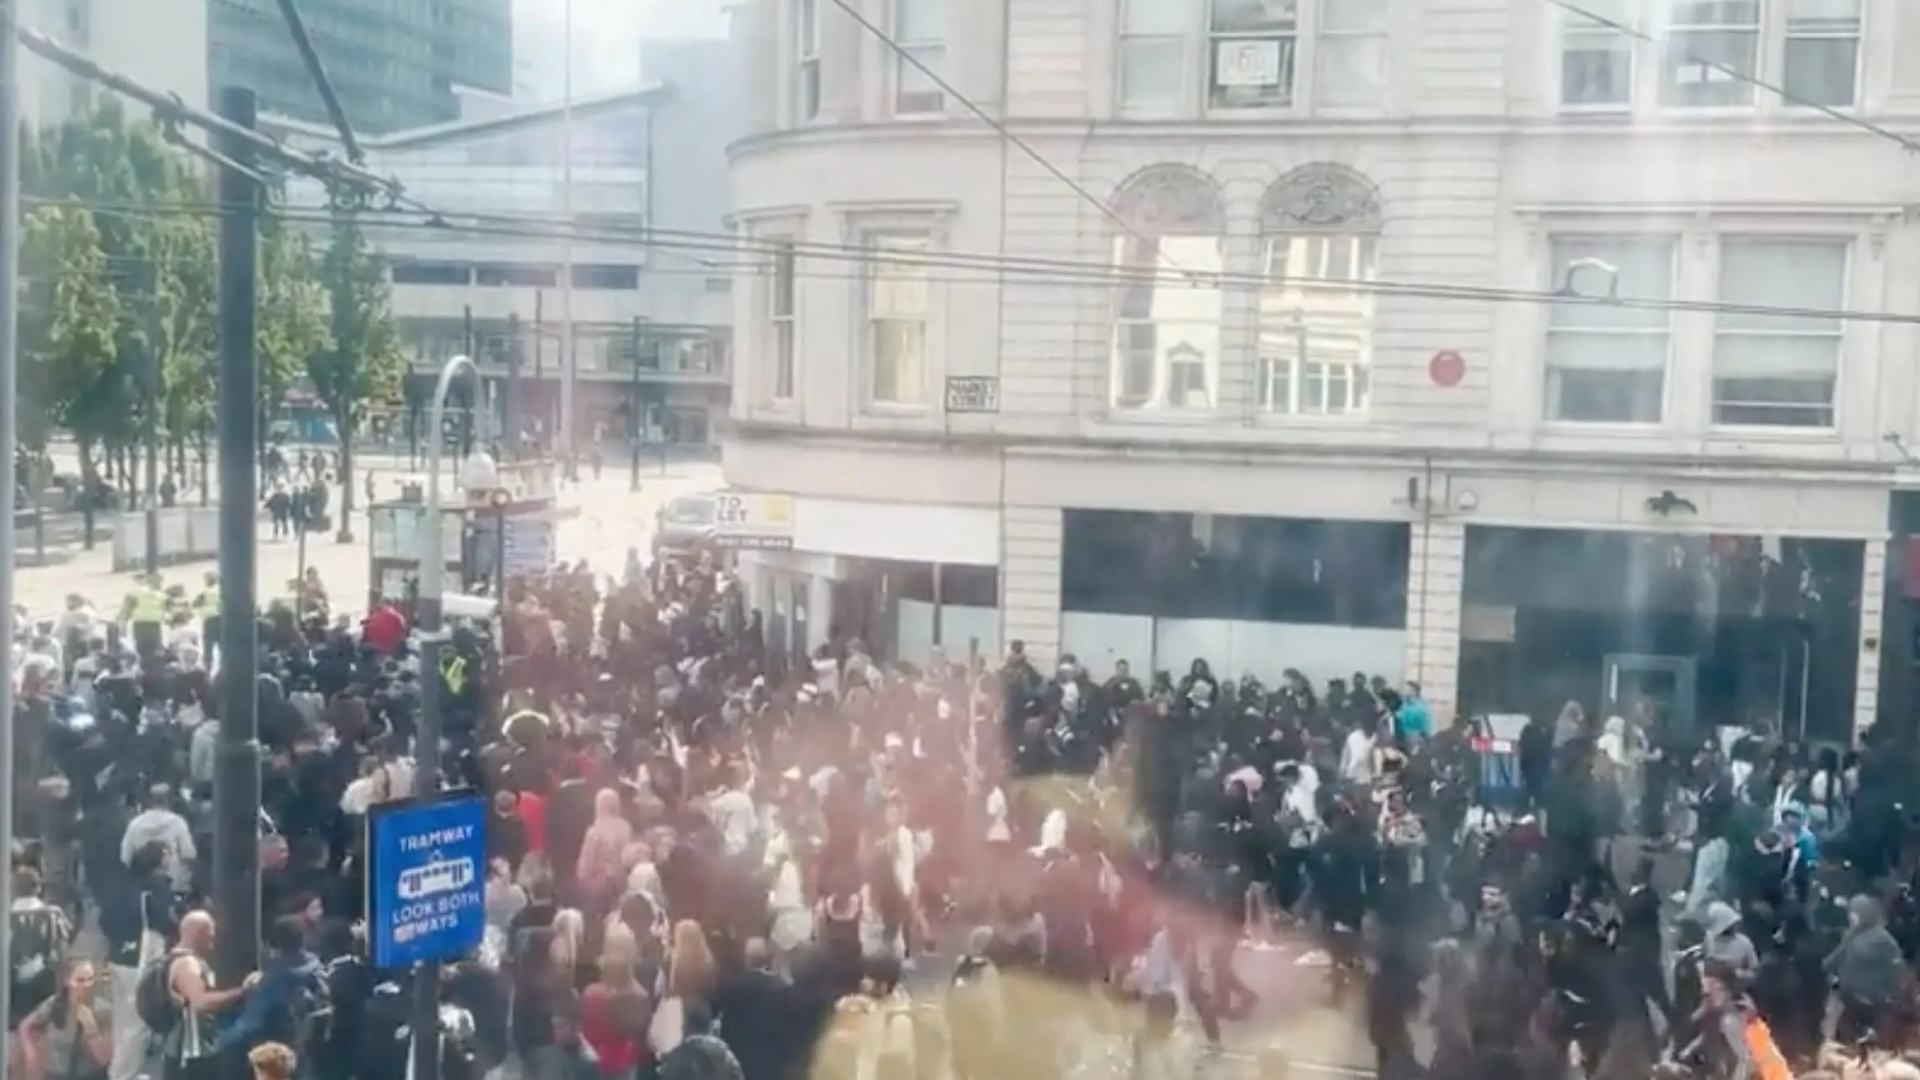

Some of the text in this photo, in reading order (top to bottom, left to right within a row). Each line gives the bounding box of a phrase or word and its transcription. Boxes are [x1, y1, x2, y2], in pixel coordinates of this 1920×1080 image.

[718, 496, 742, 508] TO
[717, 509, 748, 522] LET
[399, 825, 475, 852] TRAMWAY
[392, 891, 480, 924] LOOK BOTH
[414, 913, 459, 936] WAYS
